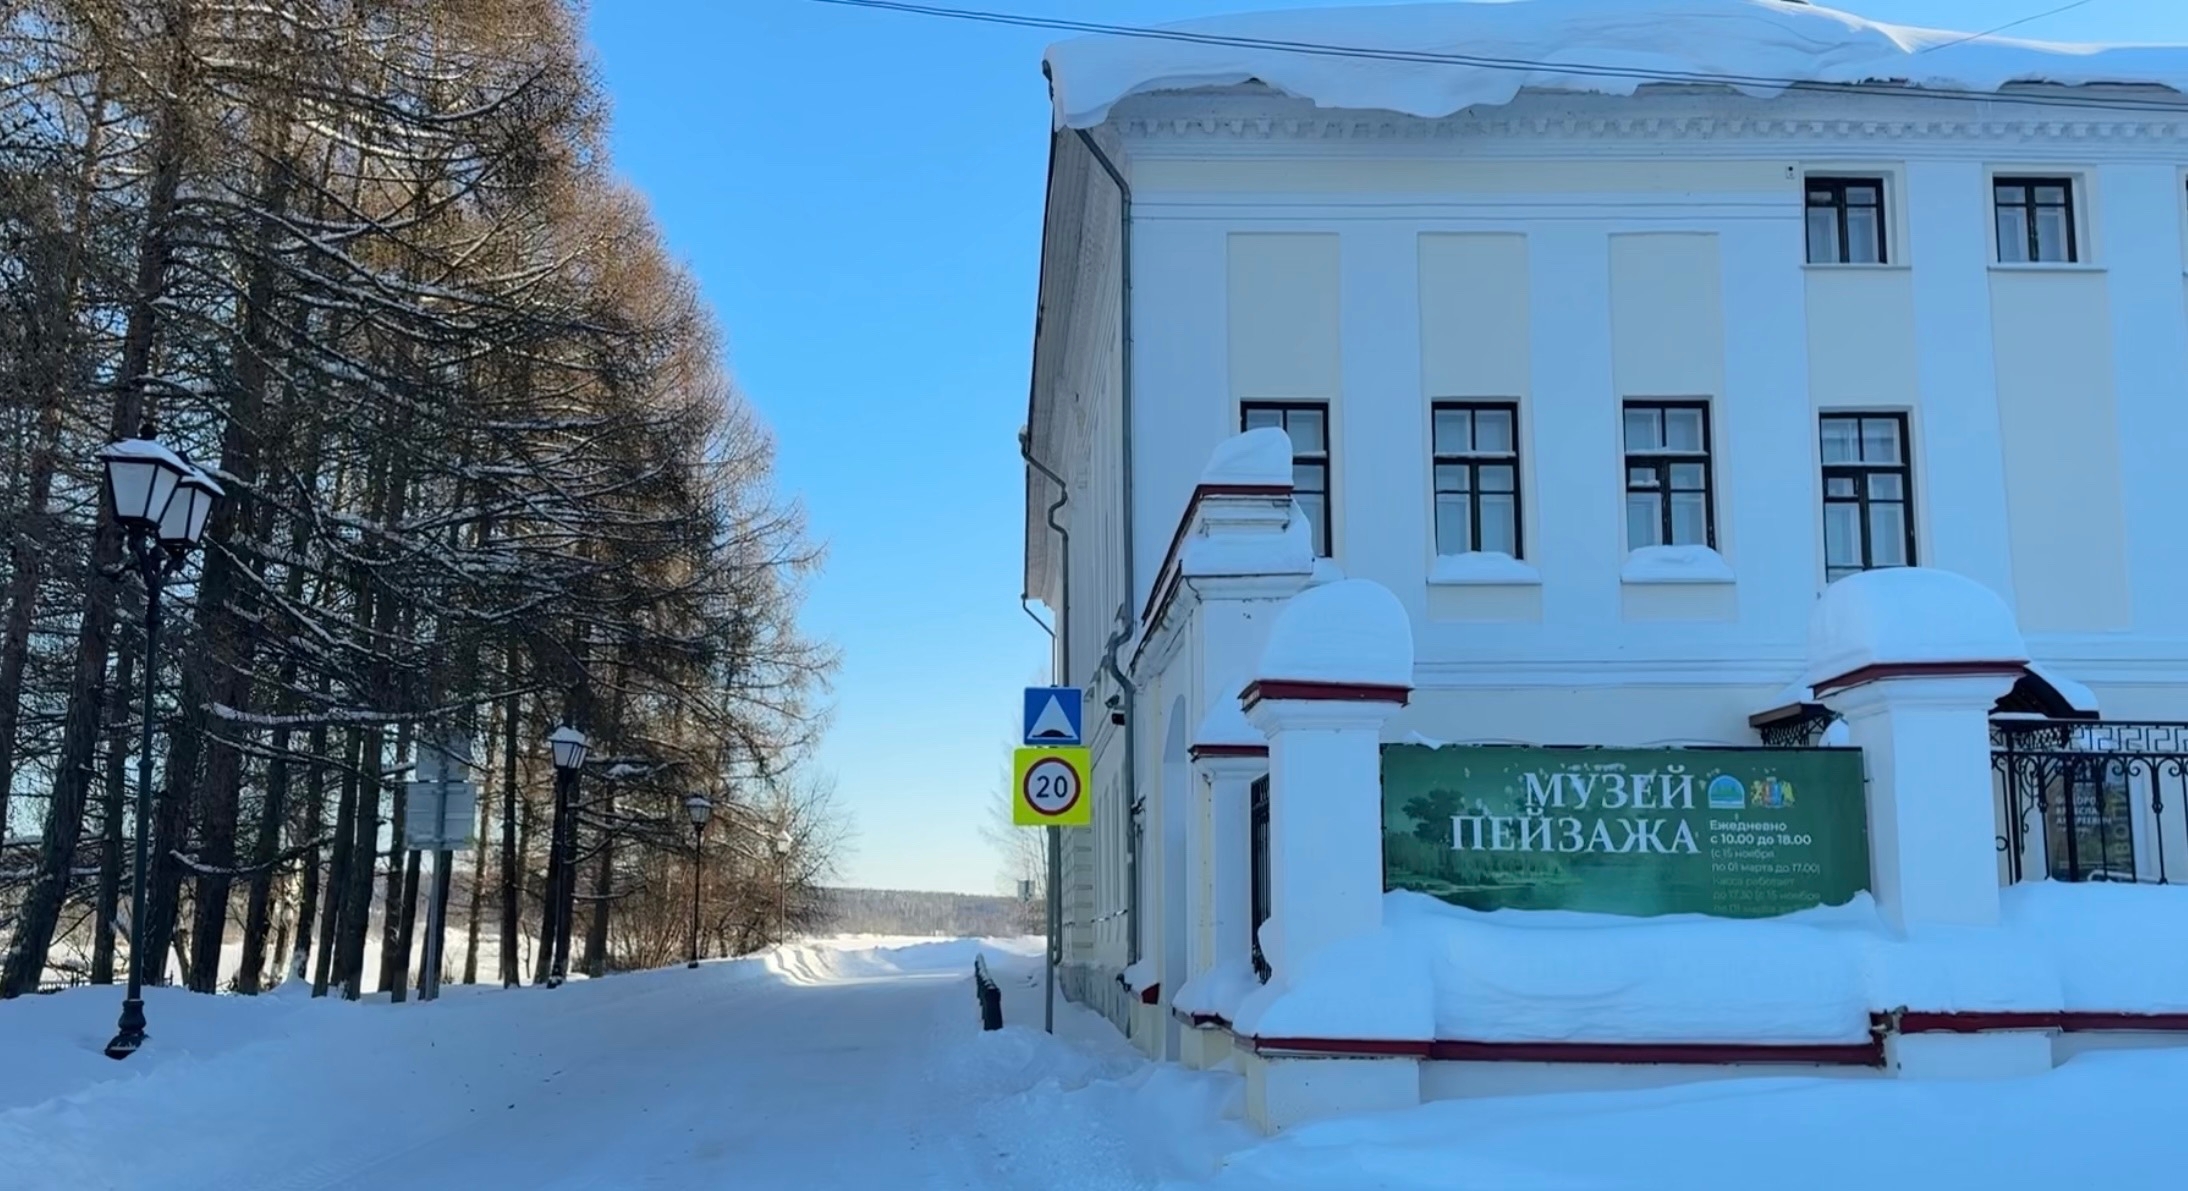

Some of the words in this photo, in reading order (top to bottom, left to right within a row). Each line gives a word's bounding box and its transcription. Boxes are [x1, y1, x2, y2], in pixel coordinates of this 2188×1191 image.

[1036, 775, 1068, 798] 20
[1523, 764, 1696, 809] МУЗЕЙ
[1449, 806, 1702, 854] ПЕЙЗАЖА
[1709, 819, 1788, 832] Ежедневно
[1710, 835, 1718, 844] с
[1721, 833, 1755, 844] 10.00
[1757, 836, 1775, 846] до
[1777, 834, 1812, 845] 18.00
[1711, 863, 1726, 873] по
[1741, 863, 1774, 874] марта
[1775, 864, 1790, 874] до
